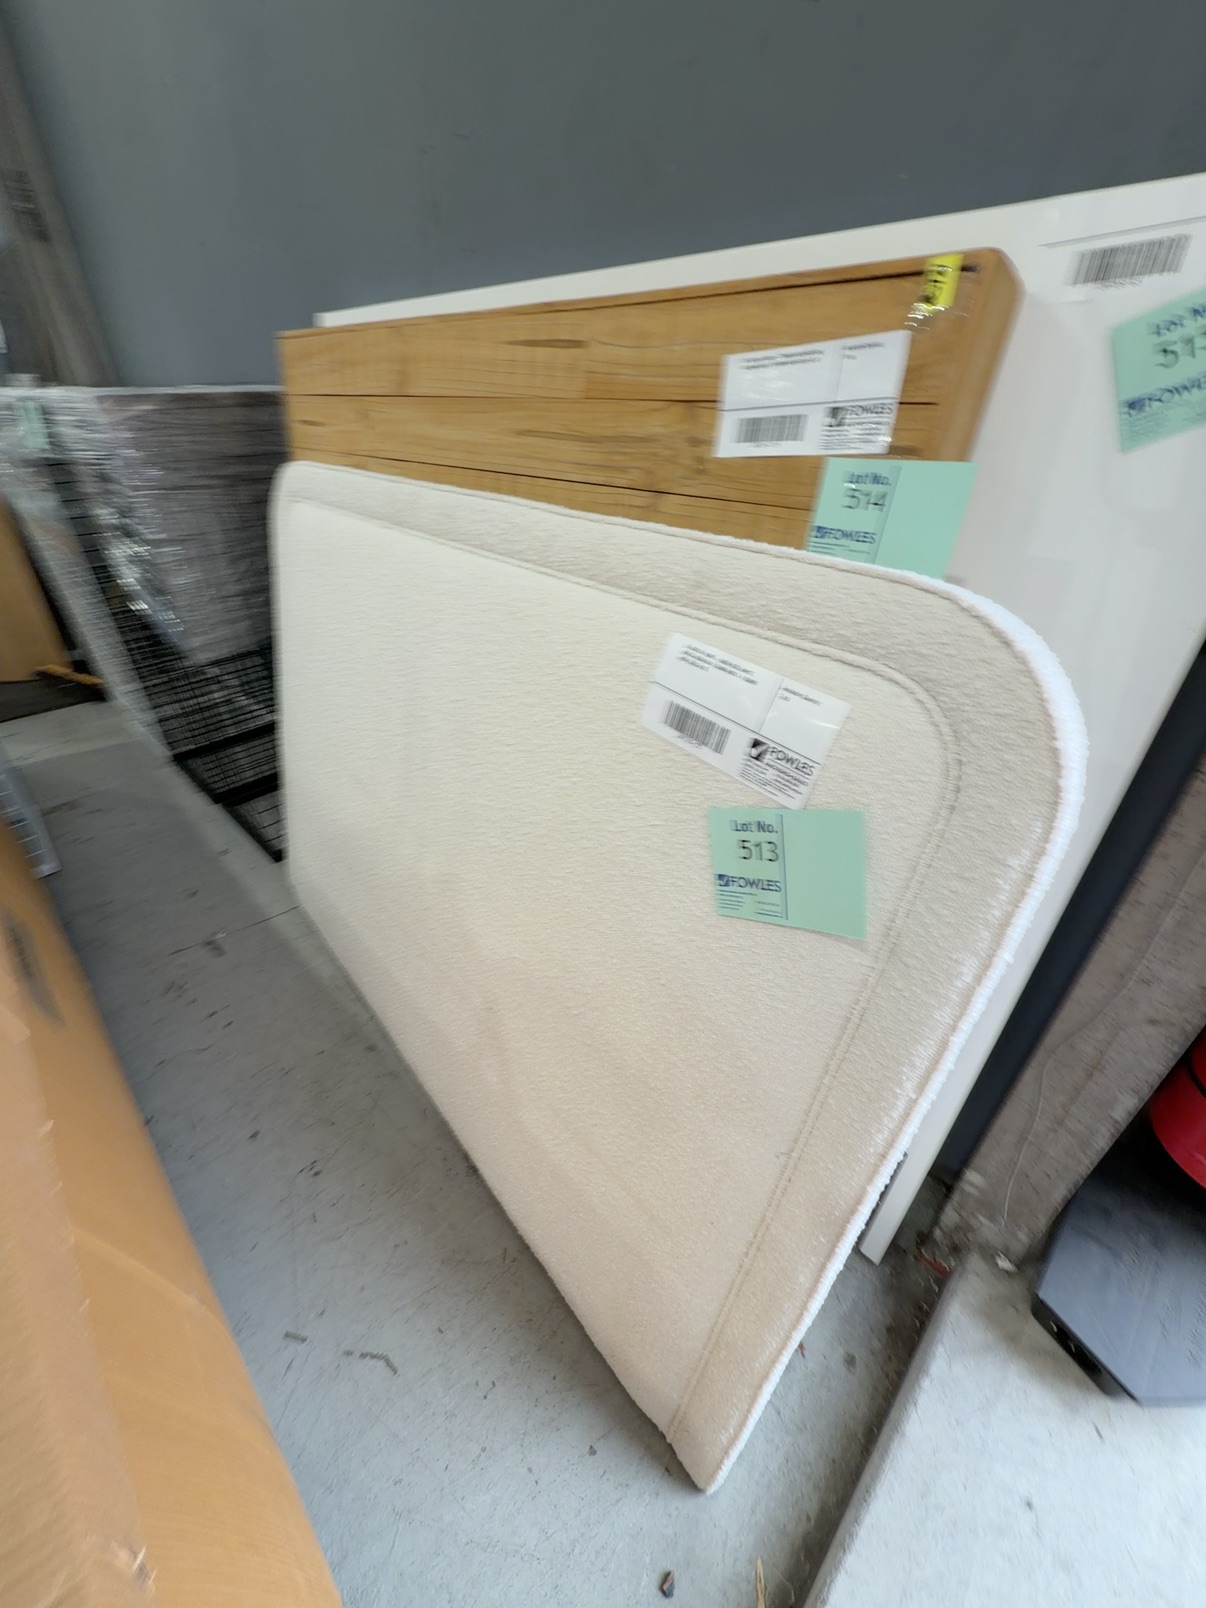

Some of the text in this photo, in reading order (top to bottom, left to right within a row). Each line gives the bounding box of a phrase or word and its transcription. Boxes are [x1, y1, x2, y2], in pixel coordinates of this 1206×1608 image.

[845, 471, 867, 484] Lot
[842, 487, 888, 512] 514
[823, 526, 877, 544] FOWLES
[768, 746, 814, 777] FOWLES
[731, 820, 778, 834] Lot No.
[738, 839, 780, 862] 513
[730, 875, 782, 892] FOWLES
